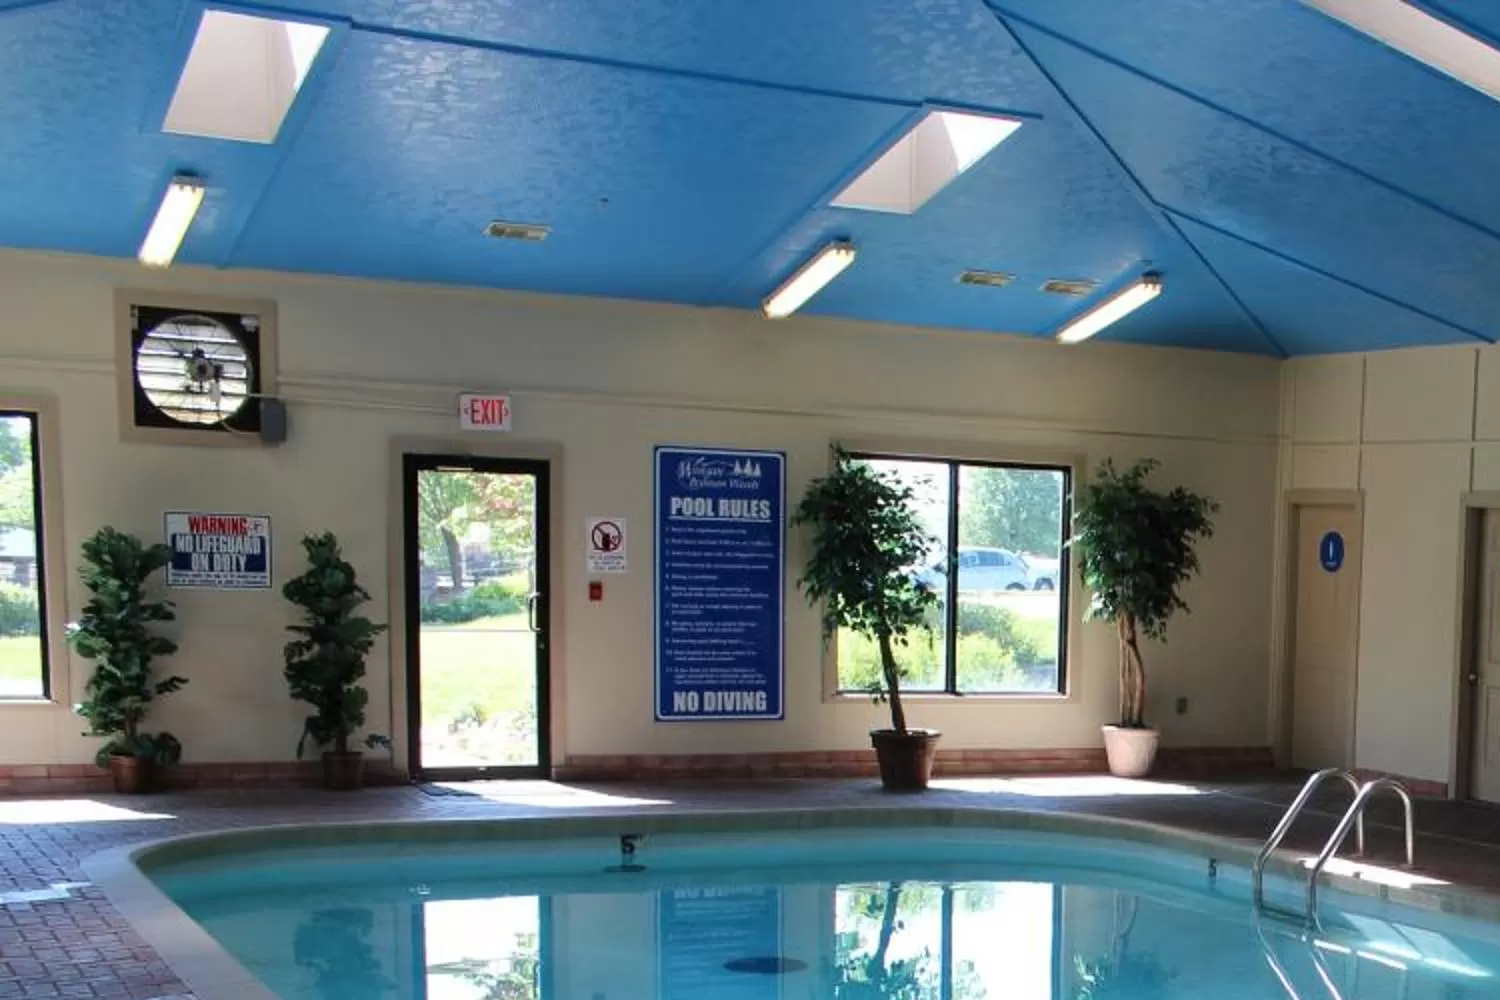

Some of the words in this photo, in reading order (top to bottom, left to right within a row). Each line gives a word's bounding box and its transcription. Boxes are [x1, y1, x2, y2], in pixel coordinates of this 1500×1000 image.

[471, 398, 505, 424] EXIT
[671, 497, 714, 517] POOL
[718, 499, 772, 519] RULES
[190, 516, 248, 535] WARNING
[176, 535, 193, 552] NO
[196, 536, 261, 554] LIFEGUARD
[191, 553, 209, 569] ON
[213, 553, 247, 570] DUTY
[673, 691, 700, 712] NO
[703, 691, 767, 712] DIVING
